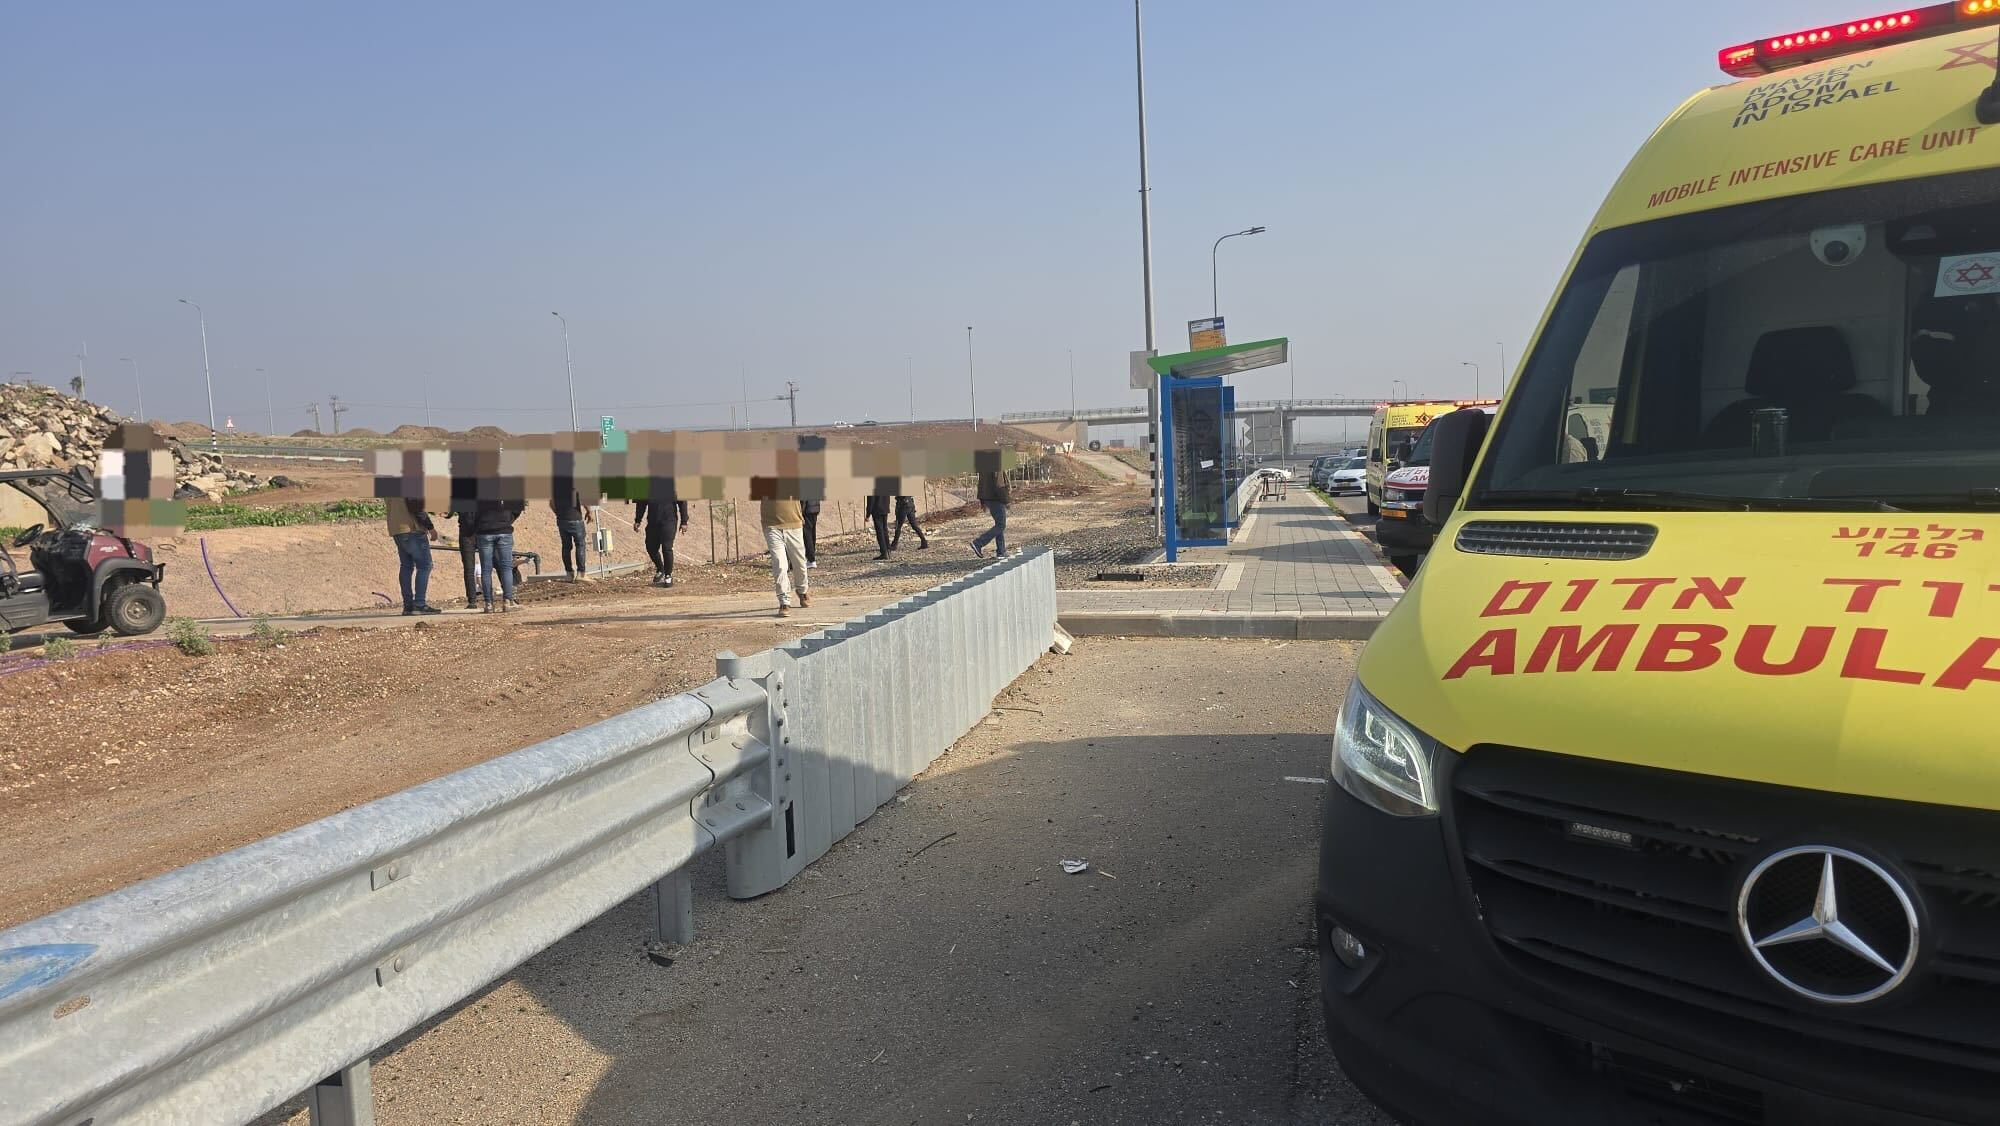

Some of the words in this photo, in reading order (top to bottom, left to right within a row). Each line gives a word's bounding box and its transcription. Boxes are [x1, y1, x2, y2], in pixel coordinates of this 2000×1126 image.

[1744, 72, 1849, 104] DAVID
[1749, 60, 1873, 95] MAGEN
[1732, 108, 1769, 128] IN
[1779, 80, 1901, 116] ISRAEL
[1738, 80, 1847, 116] ADOM
[1647, 174, 1721, 209] MOBILE
[1728, 149, 1840, 187] INTENSIVE
[1849, 137, 1911, 162] CARE
[1921, 126, 1981, 151] UNIT
[1831, 523, 1985, 541] גלבוע
[1855, 541, 1959, 560] 146
[1479, 576, 1747, 618] אדום
[1822, 577, 2000, 619] וד
